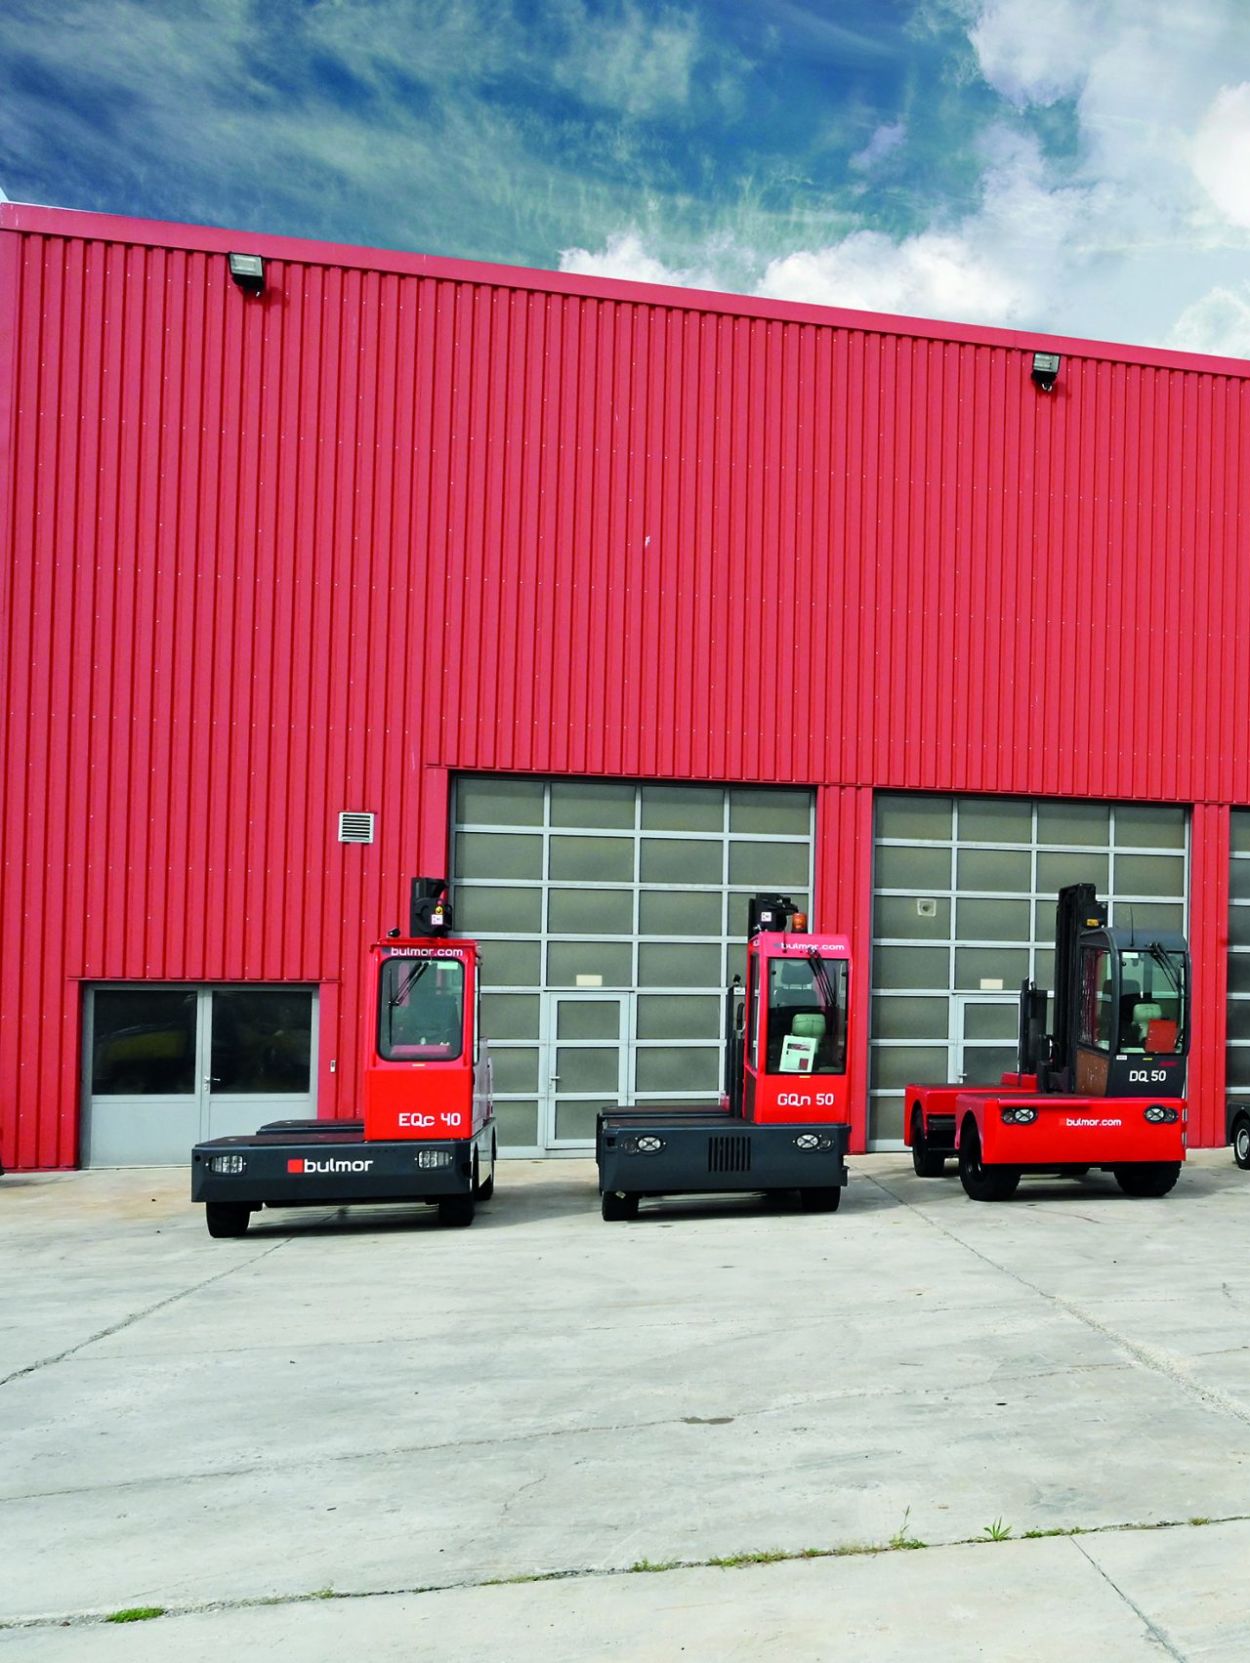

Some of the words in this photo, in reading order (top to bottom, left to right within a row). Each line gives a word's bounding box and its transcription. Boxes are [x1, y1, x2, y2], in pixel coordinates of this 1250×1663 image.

[390, 946, 464, 957] bulmor.com
[1128, 1070, 1150, 1083] DQ
[1150, 1070, 1167, 1082] 50
[777, 1093, 811, 1107] GQn
[815, 1093, 834, 1106] 50
[398, 1112, 436, 1127] EQc
[440, 1112, 462, 1127] 40
[1066, 1117, 1122, 1127] bulmor.com
[303, 1157, 374, 1174] bulmor
